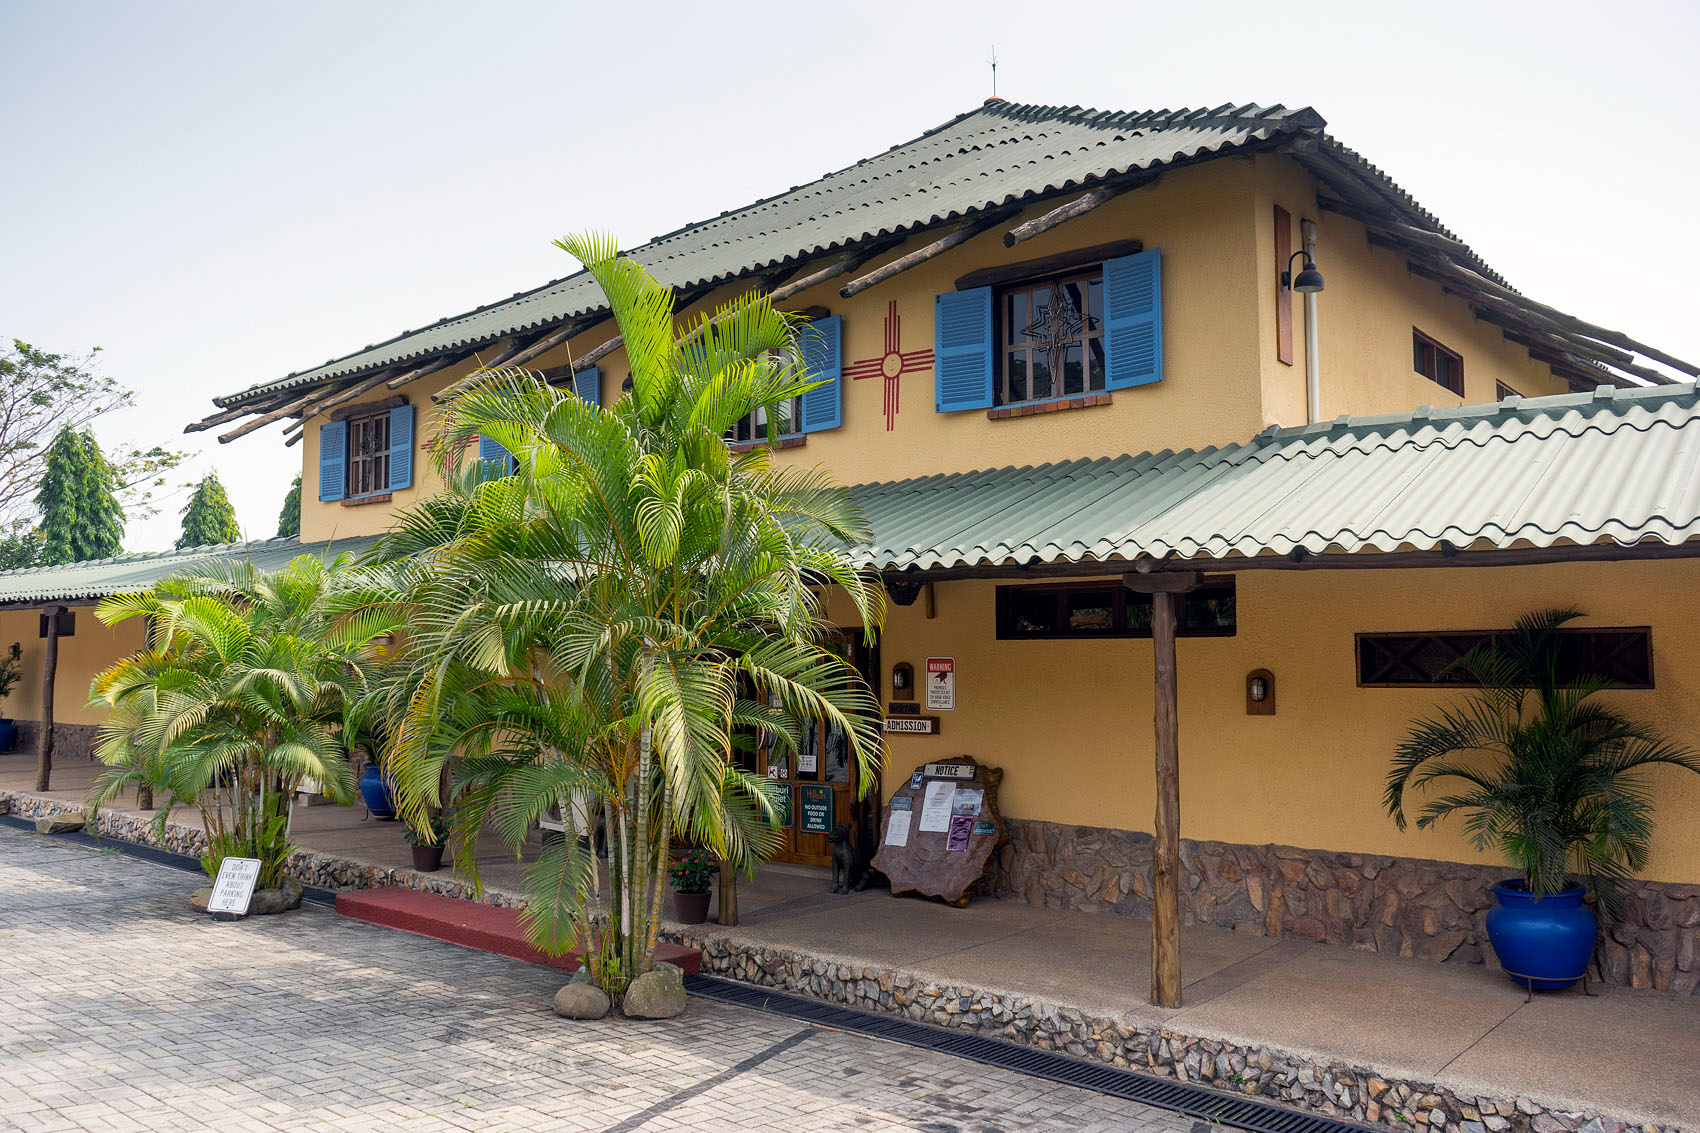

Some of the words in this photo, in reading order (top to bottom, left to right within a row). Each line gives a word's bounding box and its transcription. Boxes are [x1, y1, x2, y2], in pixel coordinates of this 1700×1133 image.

[929, 663, 952, 671] WARNING
[887, 720, 927, 731] ADMISSION
[935, 765, 960, 776] NOTICE
[222, 872, 237, 880] EVEN
[220, 889, 245, 898] PARKING
[222, 898, 236, 906] HERE
